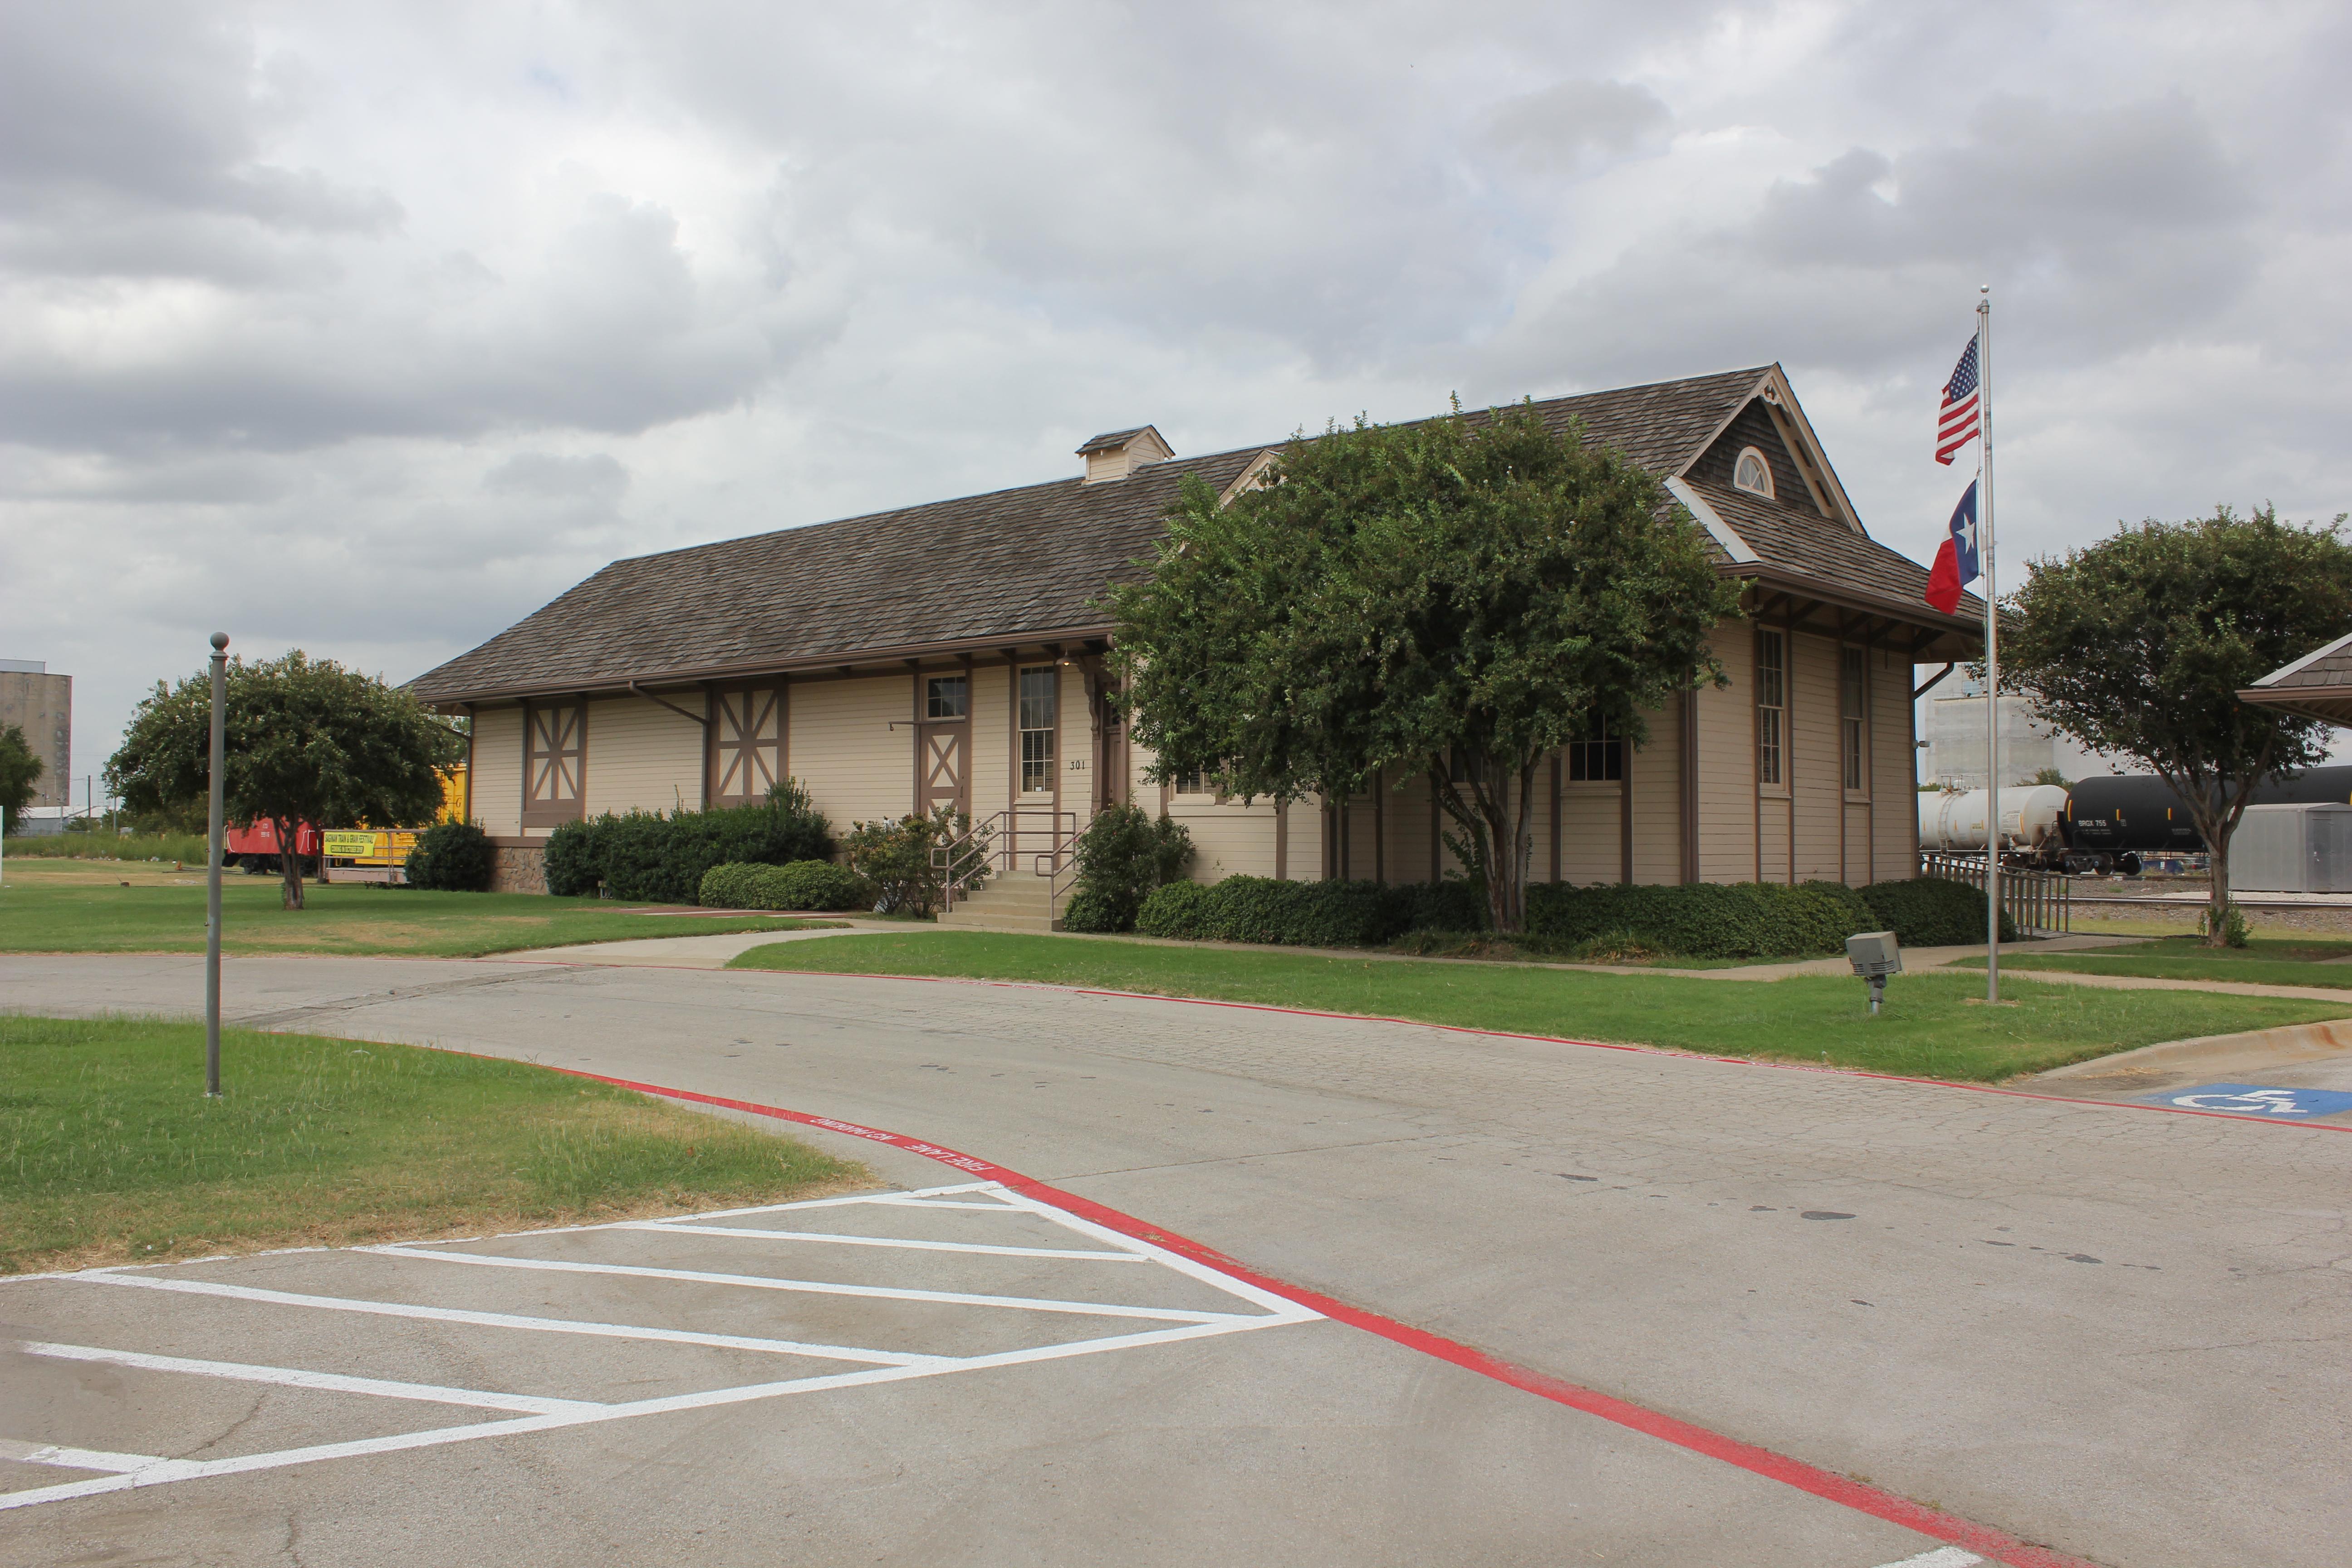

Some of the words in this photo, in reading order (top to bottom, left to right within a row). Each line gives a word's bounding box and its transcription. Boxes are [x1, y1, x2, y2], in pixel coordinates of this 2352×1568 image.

[1070, 760, 1085, 770] 301
[358, 835, 374, 844] FESTIVAL
[809, 1118, 876, 1135] PARKING
[903, 1144, 957, 1159] LANE
[944, 1157, 994, 1171] FIRE
